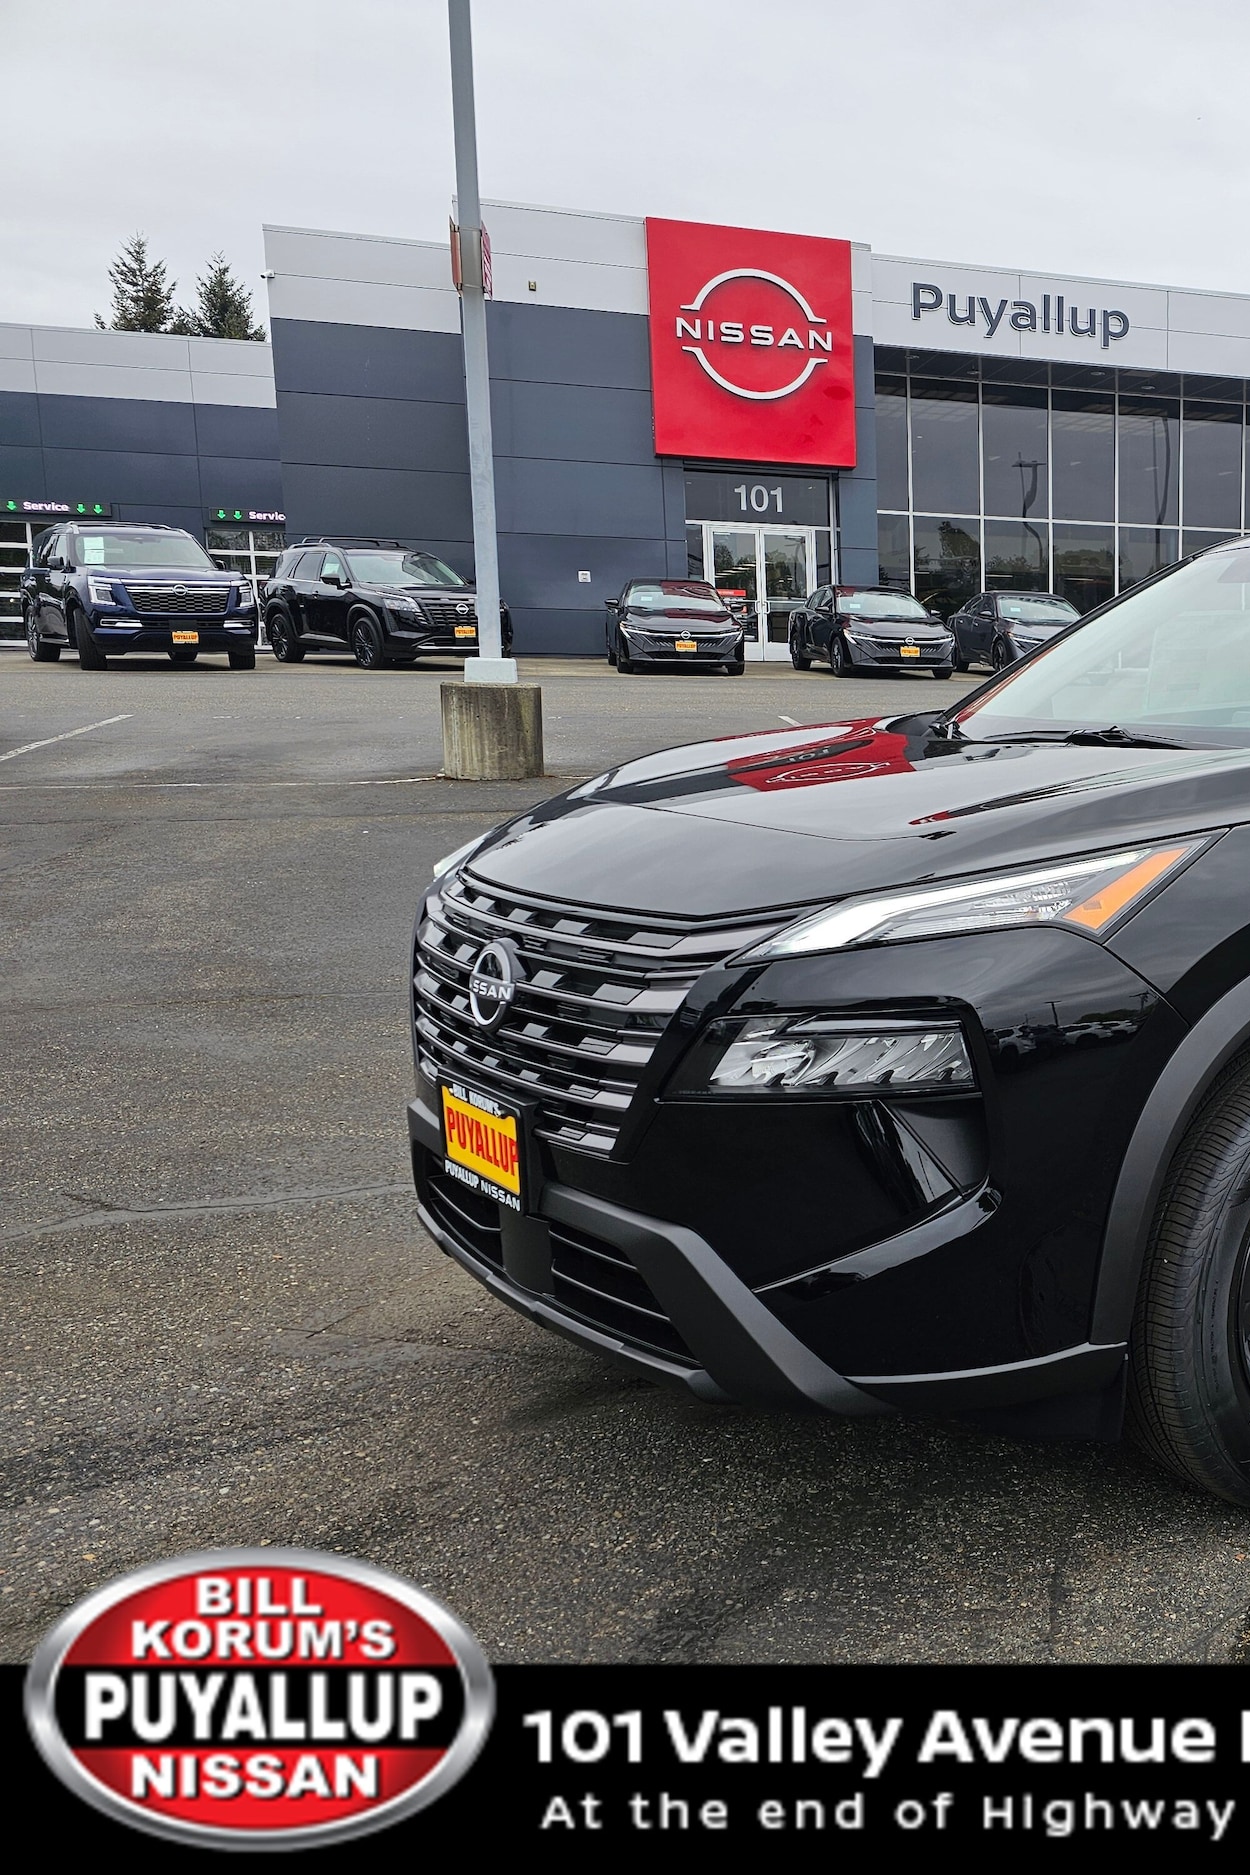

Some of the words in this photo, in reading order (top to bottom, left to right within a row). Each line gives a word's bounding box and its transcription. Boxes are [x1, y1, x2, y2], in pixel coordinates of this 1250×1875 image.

[675, 315, 833, 352] NISSAN
[911, 281, 1130, 349] Puyallup
[22, 500, 71, 513] Service
[248, 510, 286, 522] Servic
[734, 484, 784, 513] 101
[446, 1106, 519, 1177] PUYALLUP
[444, 1159, 480, 1189] PUYALLUP
[480, 1180, 521, 1212] NISSAN
